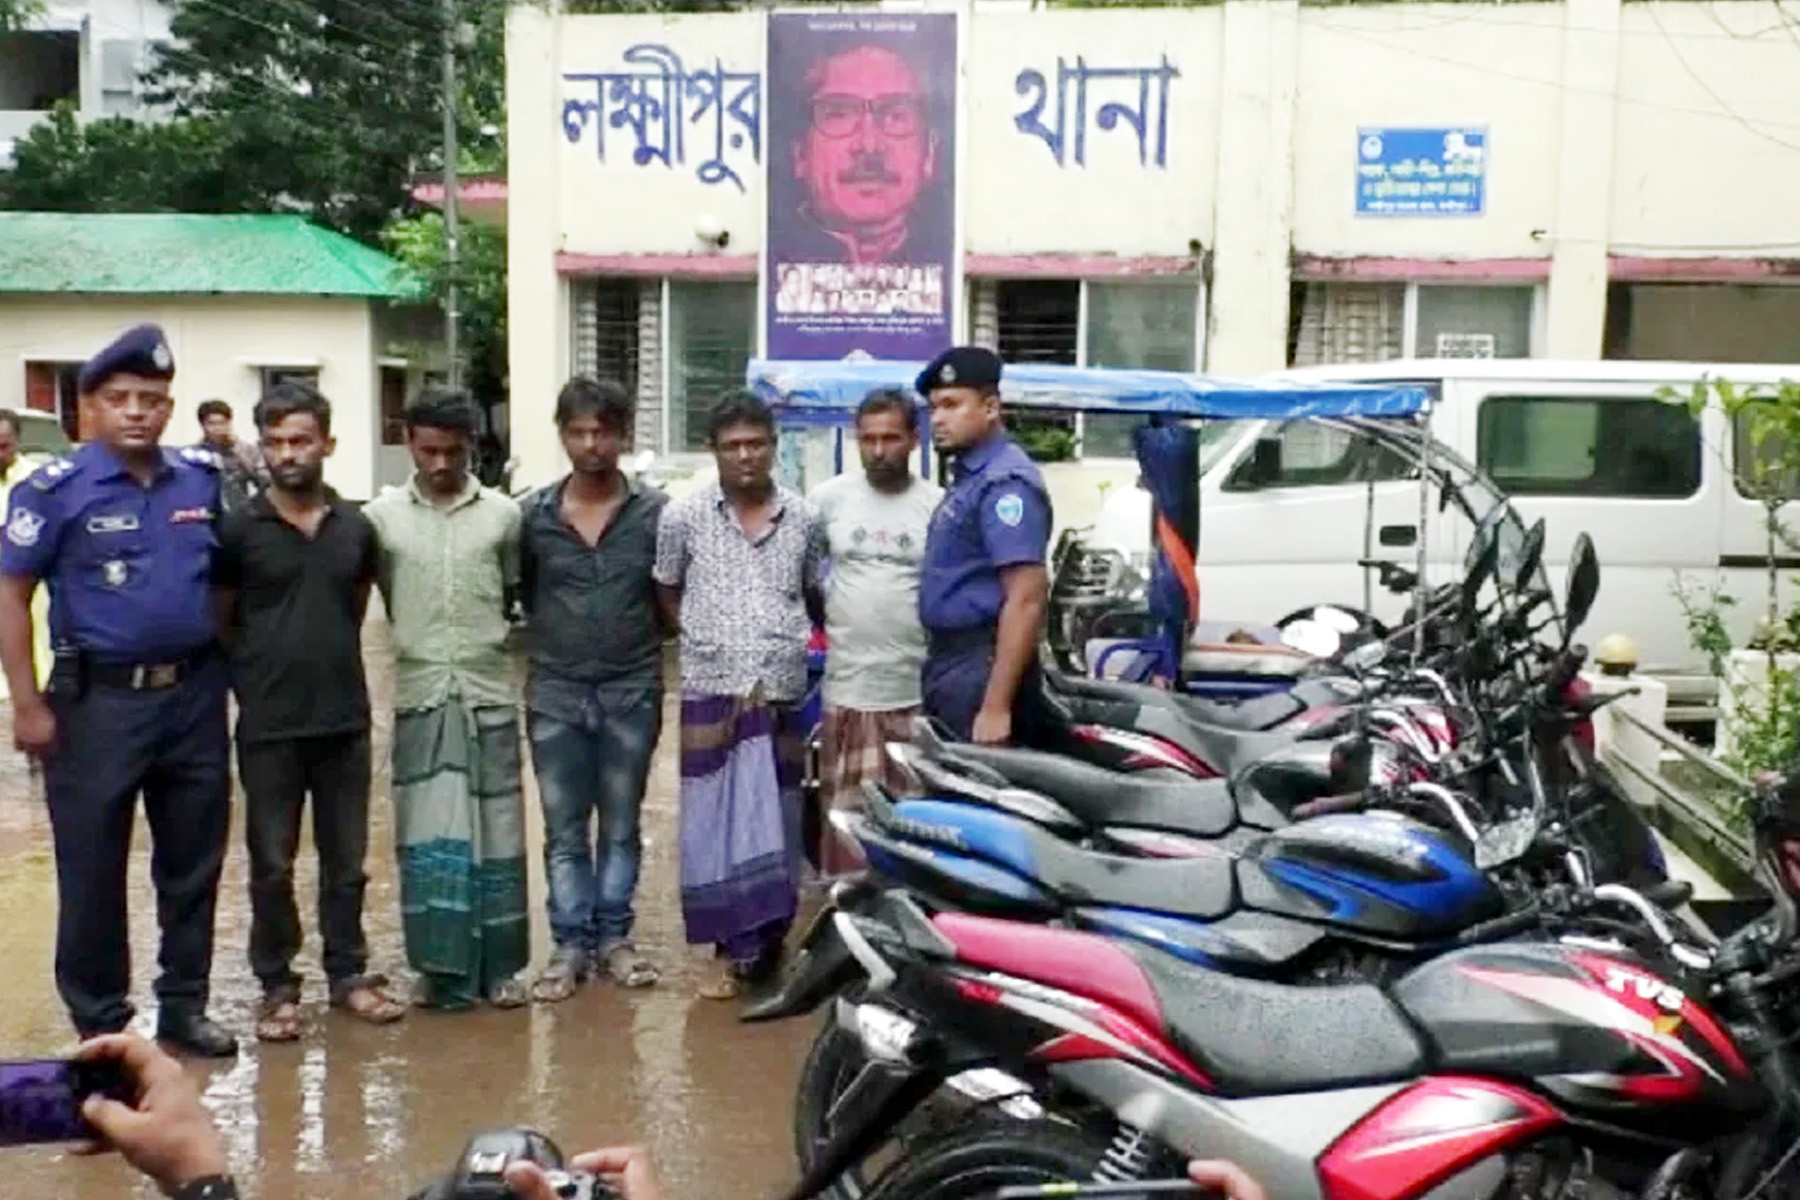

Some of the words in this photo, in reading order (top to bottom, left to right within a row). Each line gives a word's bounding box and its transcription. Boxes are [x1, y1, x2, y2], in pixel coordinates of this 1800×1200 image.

[562, 44, 760, 194] লক্ষ্মীপুর
[1014, 54, 1181, 169] থানা
[1605, 968, 1684, 1010] TVS
